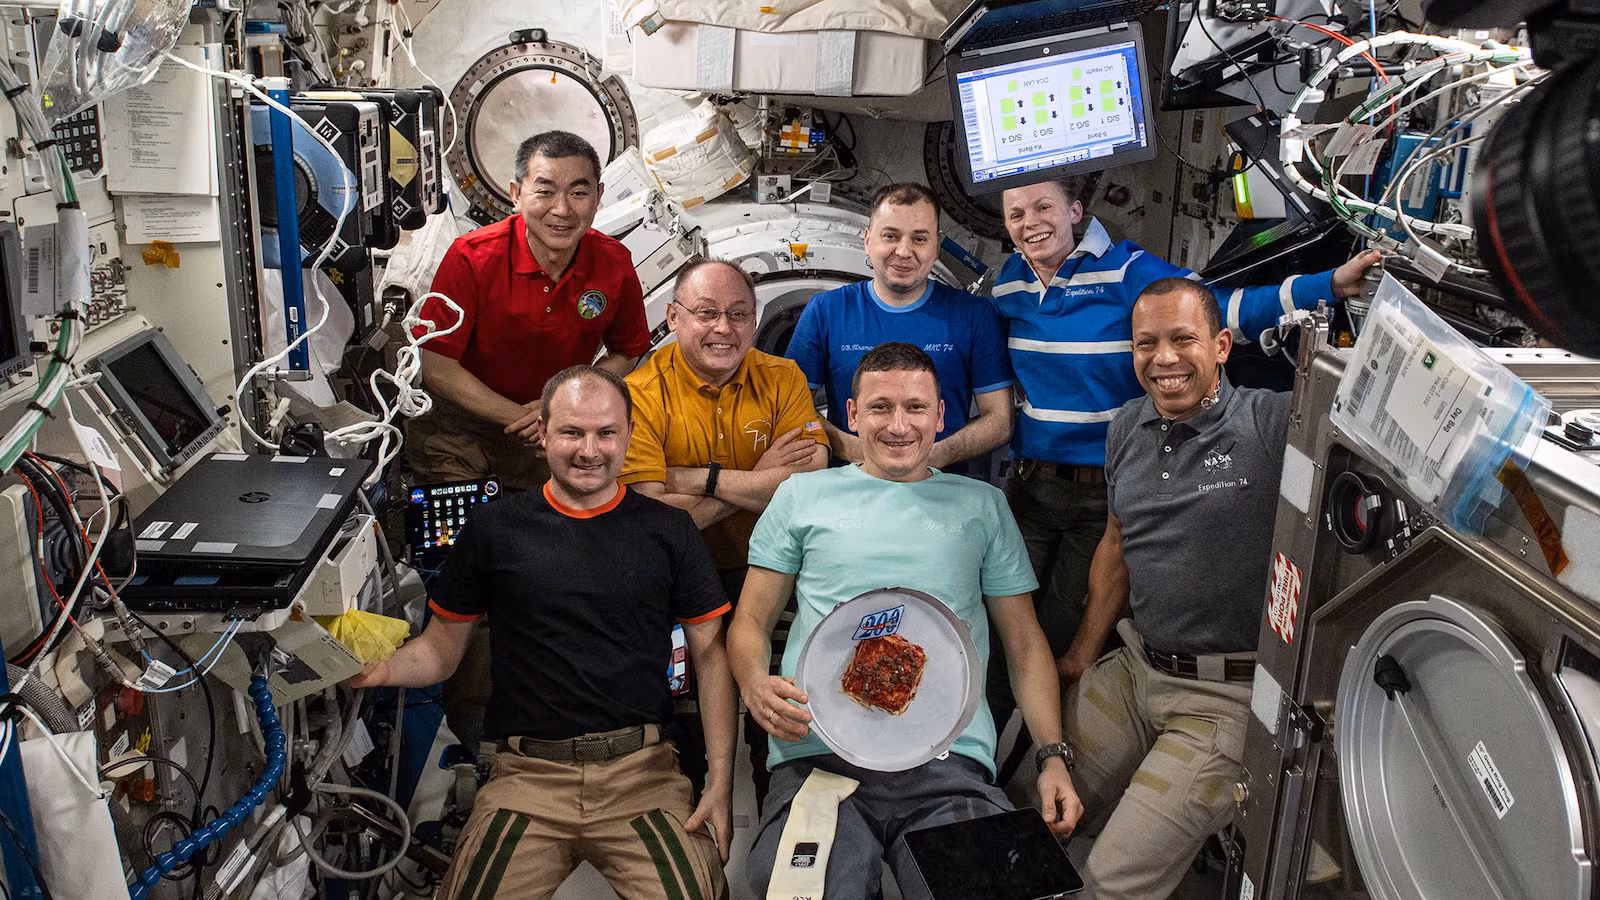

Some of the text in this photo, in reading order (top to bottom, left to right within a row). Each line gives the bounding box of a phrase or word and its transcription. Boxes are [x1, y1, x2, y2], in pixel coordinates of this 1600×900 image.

[1085, 66, 1103, 75] Health
[1106, 114, 1120, 123] S/G
[1075, 120, 1090, 129] S/G
[1039, 127, 1054, 136] S/G
[1088, 131, 1108, 140] S-Band
[1001, 133, 1022, 144] S/G 4
[1018, 144, 1042, 154] Ku-Band
[943, 343, 953, 352] 74
[1443, 407, 1462, 432] Day Bag
[1204, 454, 1232, 468] NASA
[1198, 478, 1248, 492] Expedition 74
[1285, 575, 1293, 614] EMERGENCY
[1277, 595, 1285, 626] PORT
[858, 608, 900, 638] 200
[1484, 755, 1494, 772] Glove
[1494, 772, 1503, 788] Ring
[1501, 788, 1510, 803] Plug
